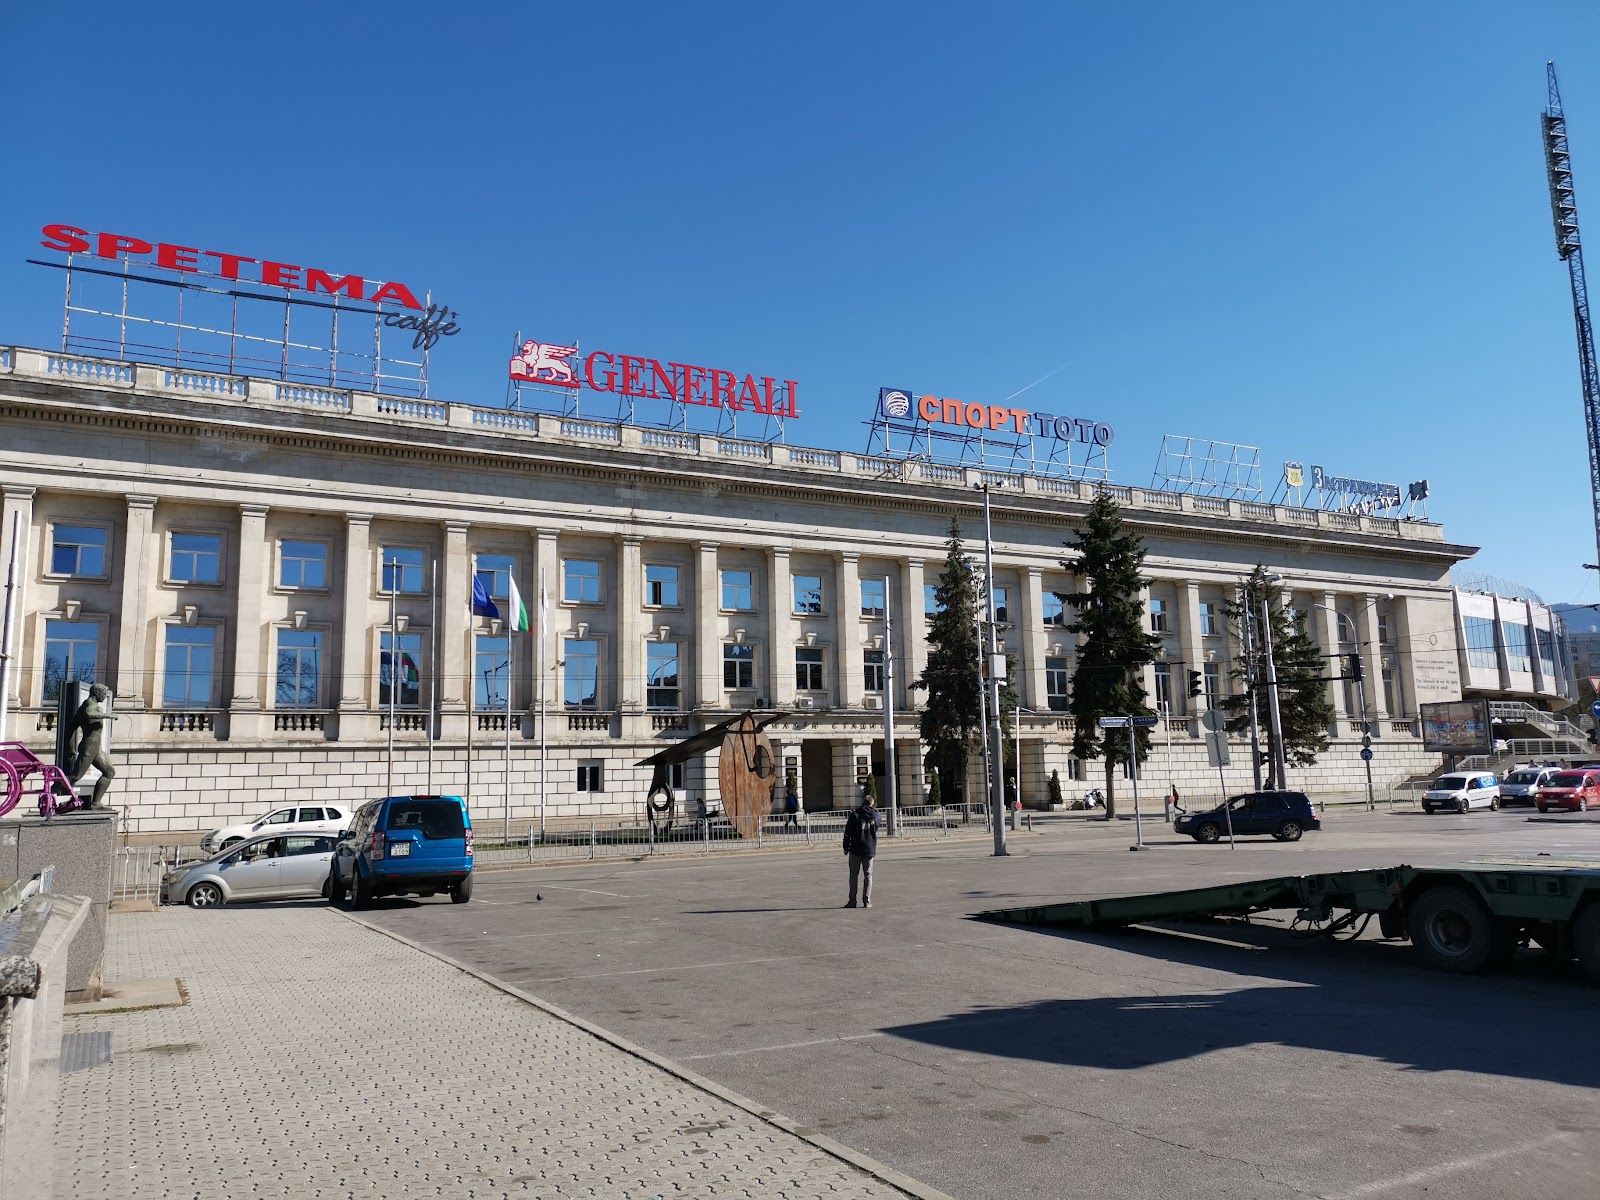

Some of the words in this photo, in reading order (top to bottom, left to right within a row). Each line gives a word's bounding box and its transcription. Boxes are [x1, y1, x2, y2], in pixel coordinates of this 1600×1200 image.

[40, 224, 423, 310] SPETEMA
[584, 350, 799, 419] GENERALI
[917, 395, 1029, 434] СПОРТ
[1034, 412, 1115, 447] ТОТО
